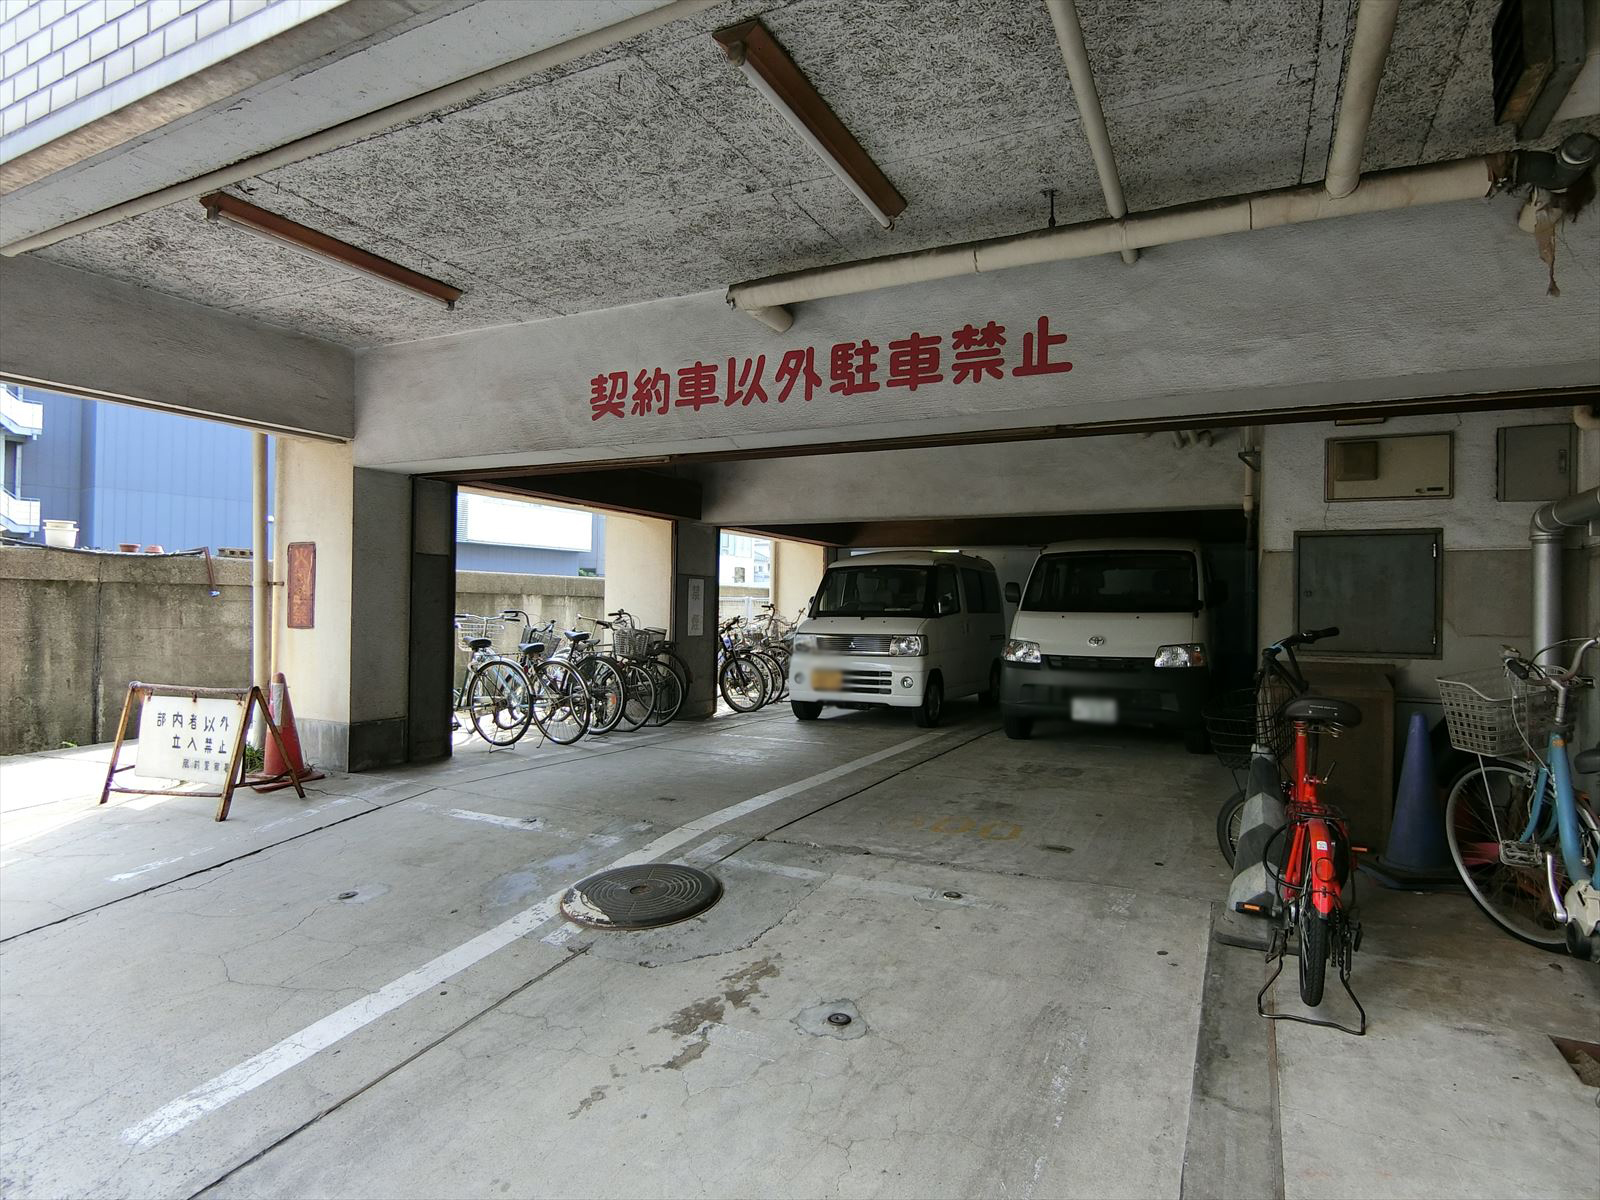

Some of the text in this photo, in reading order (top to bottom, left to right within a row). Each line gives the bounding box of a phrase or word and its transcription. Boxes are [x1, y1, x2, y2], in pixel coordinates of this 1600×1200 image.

[590, 315, 1074, 422] 契約車以外駐車禁止
[156, 711, 229, 732] 部内者以外
[172, 734, 227, 754] 立入禁止
